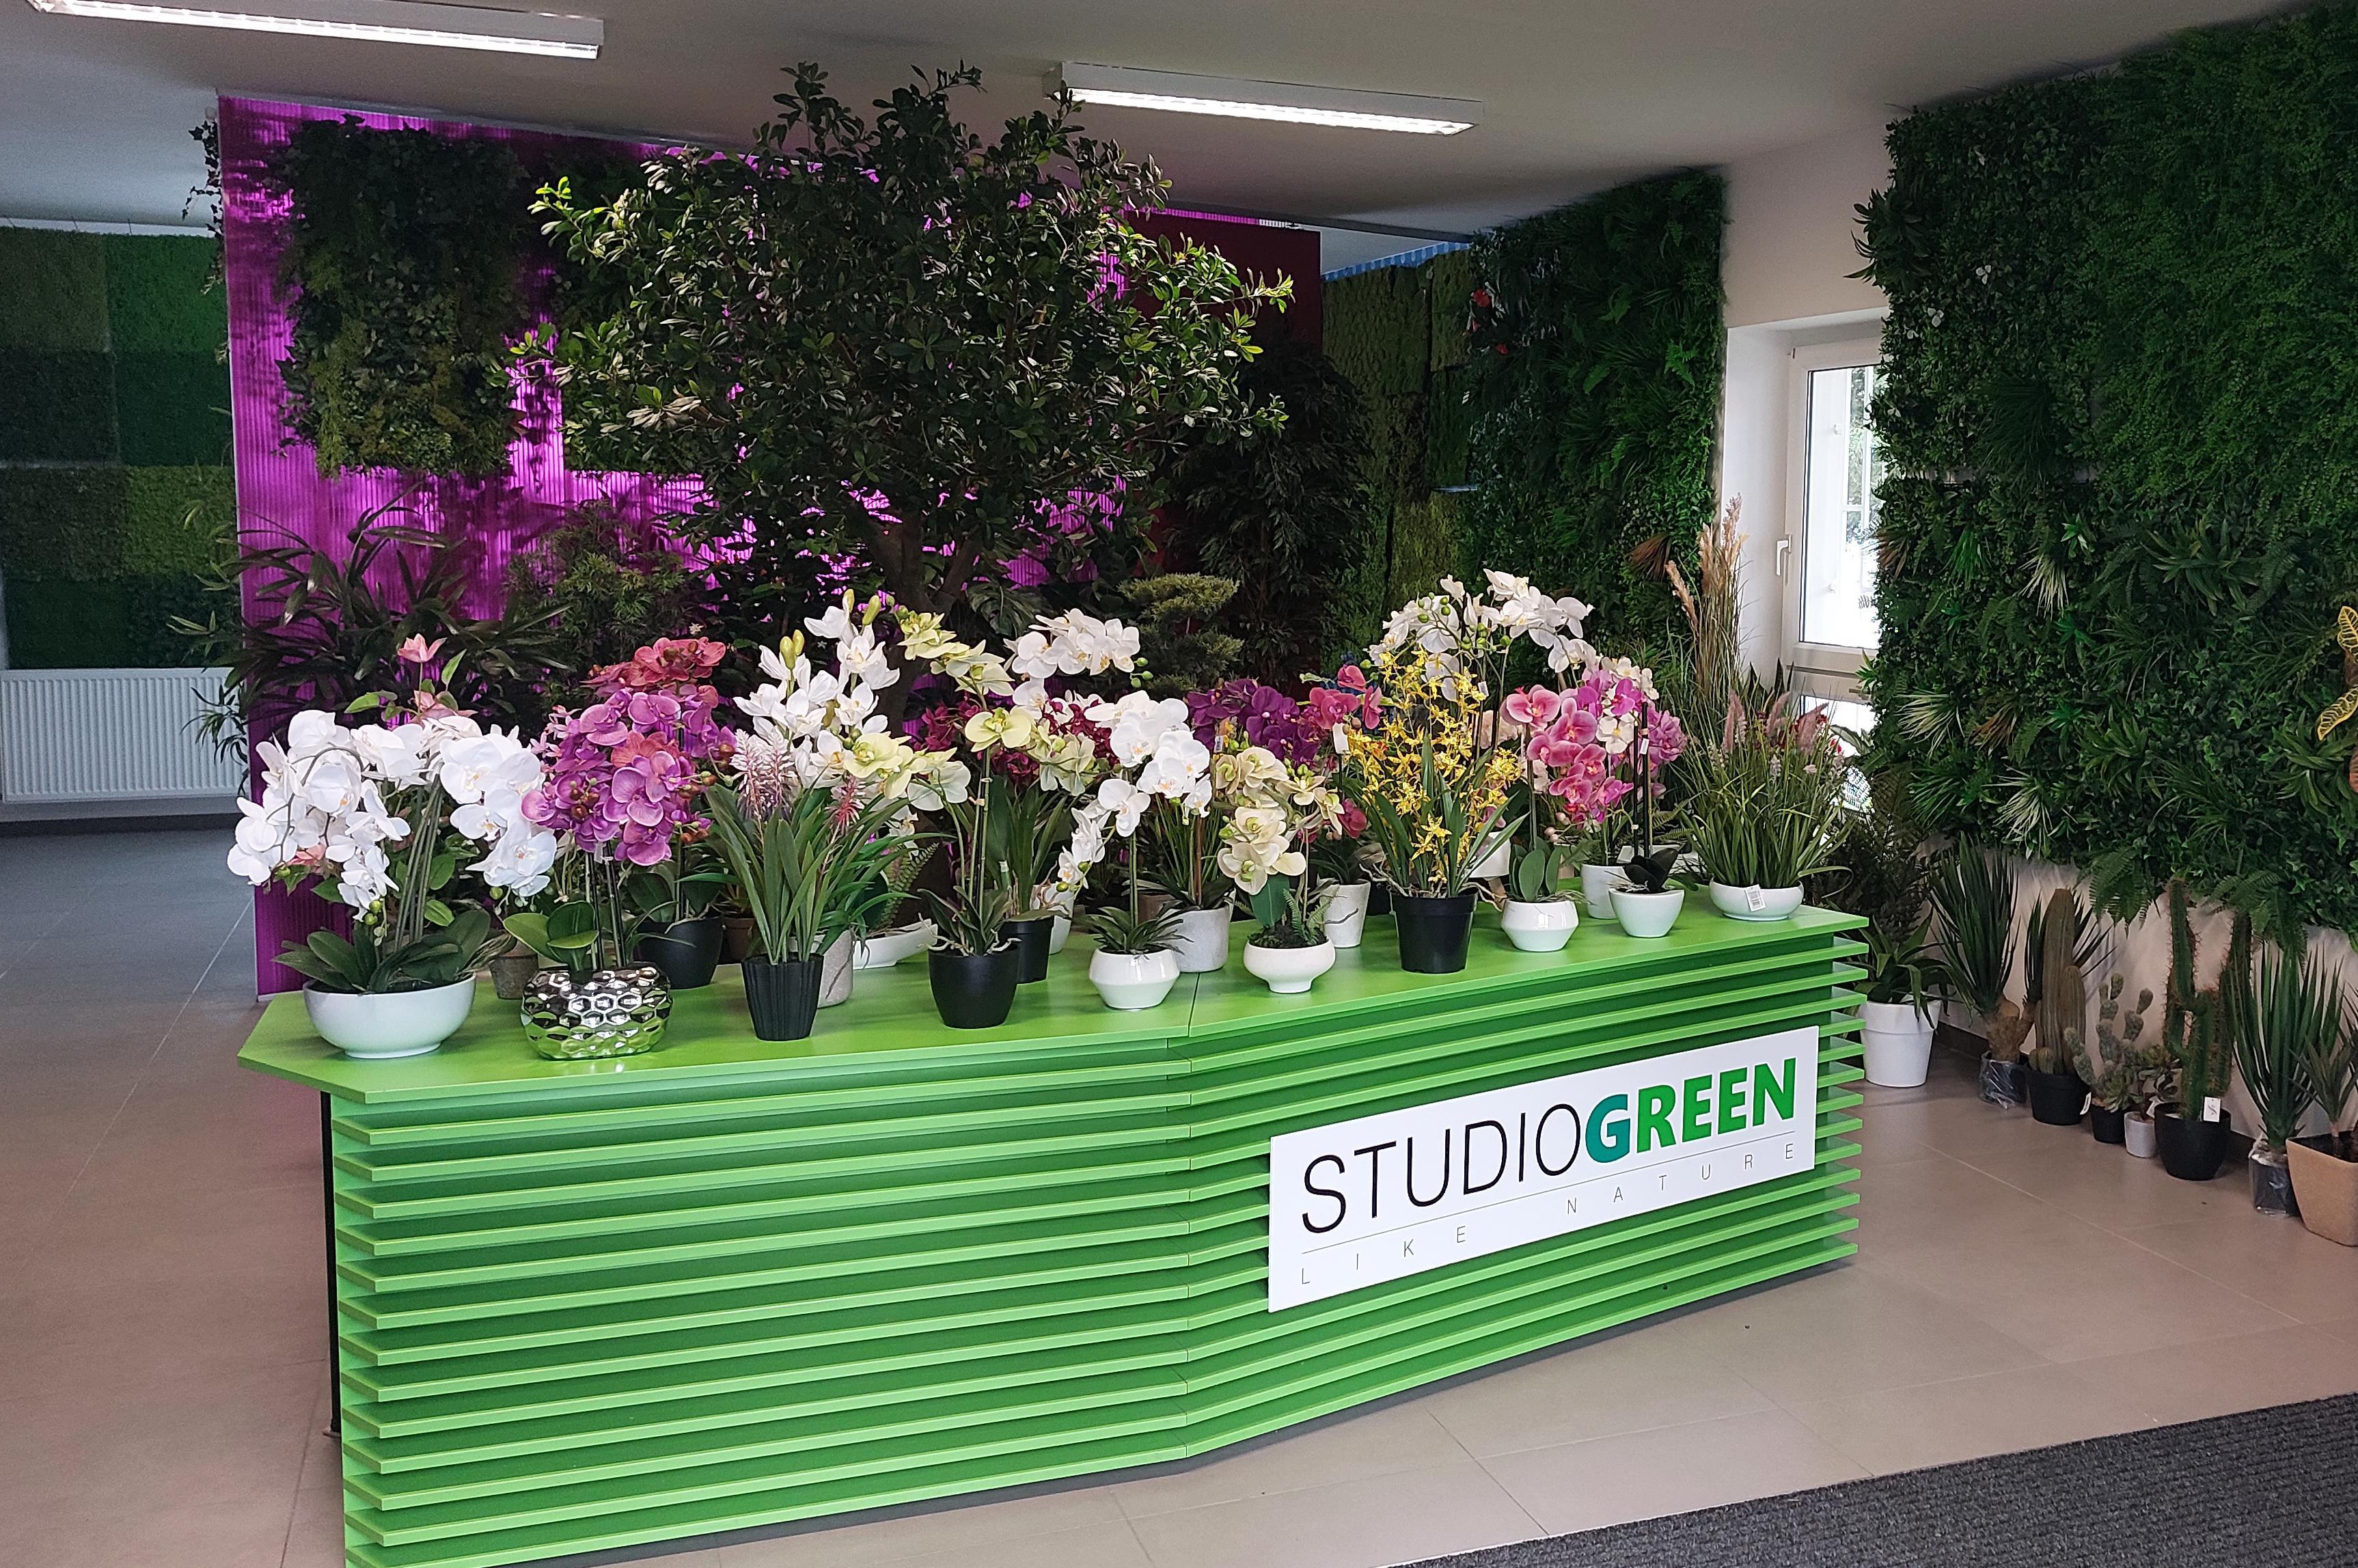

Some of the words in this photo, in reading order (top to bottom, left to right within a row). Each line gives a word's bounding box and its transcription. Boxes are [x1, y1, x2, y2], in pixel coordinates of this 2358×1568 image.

[1302, 1058, 1796, 1233] STUDIOGREEN
[1302, 1226, 1466, 1284] LIKE
[1567, 1144, 1794, 1213] NATURE
